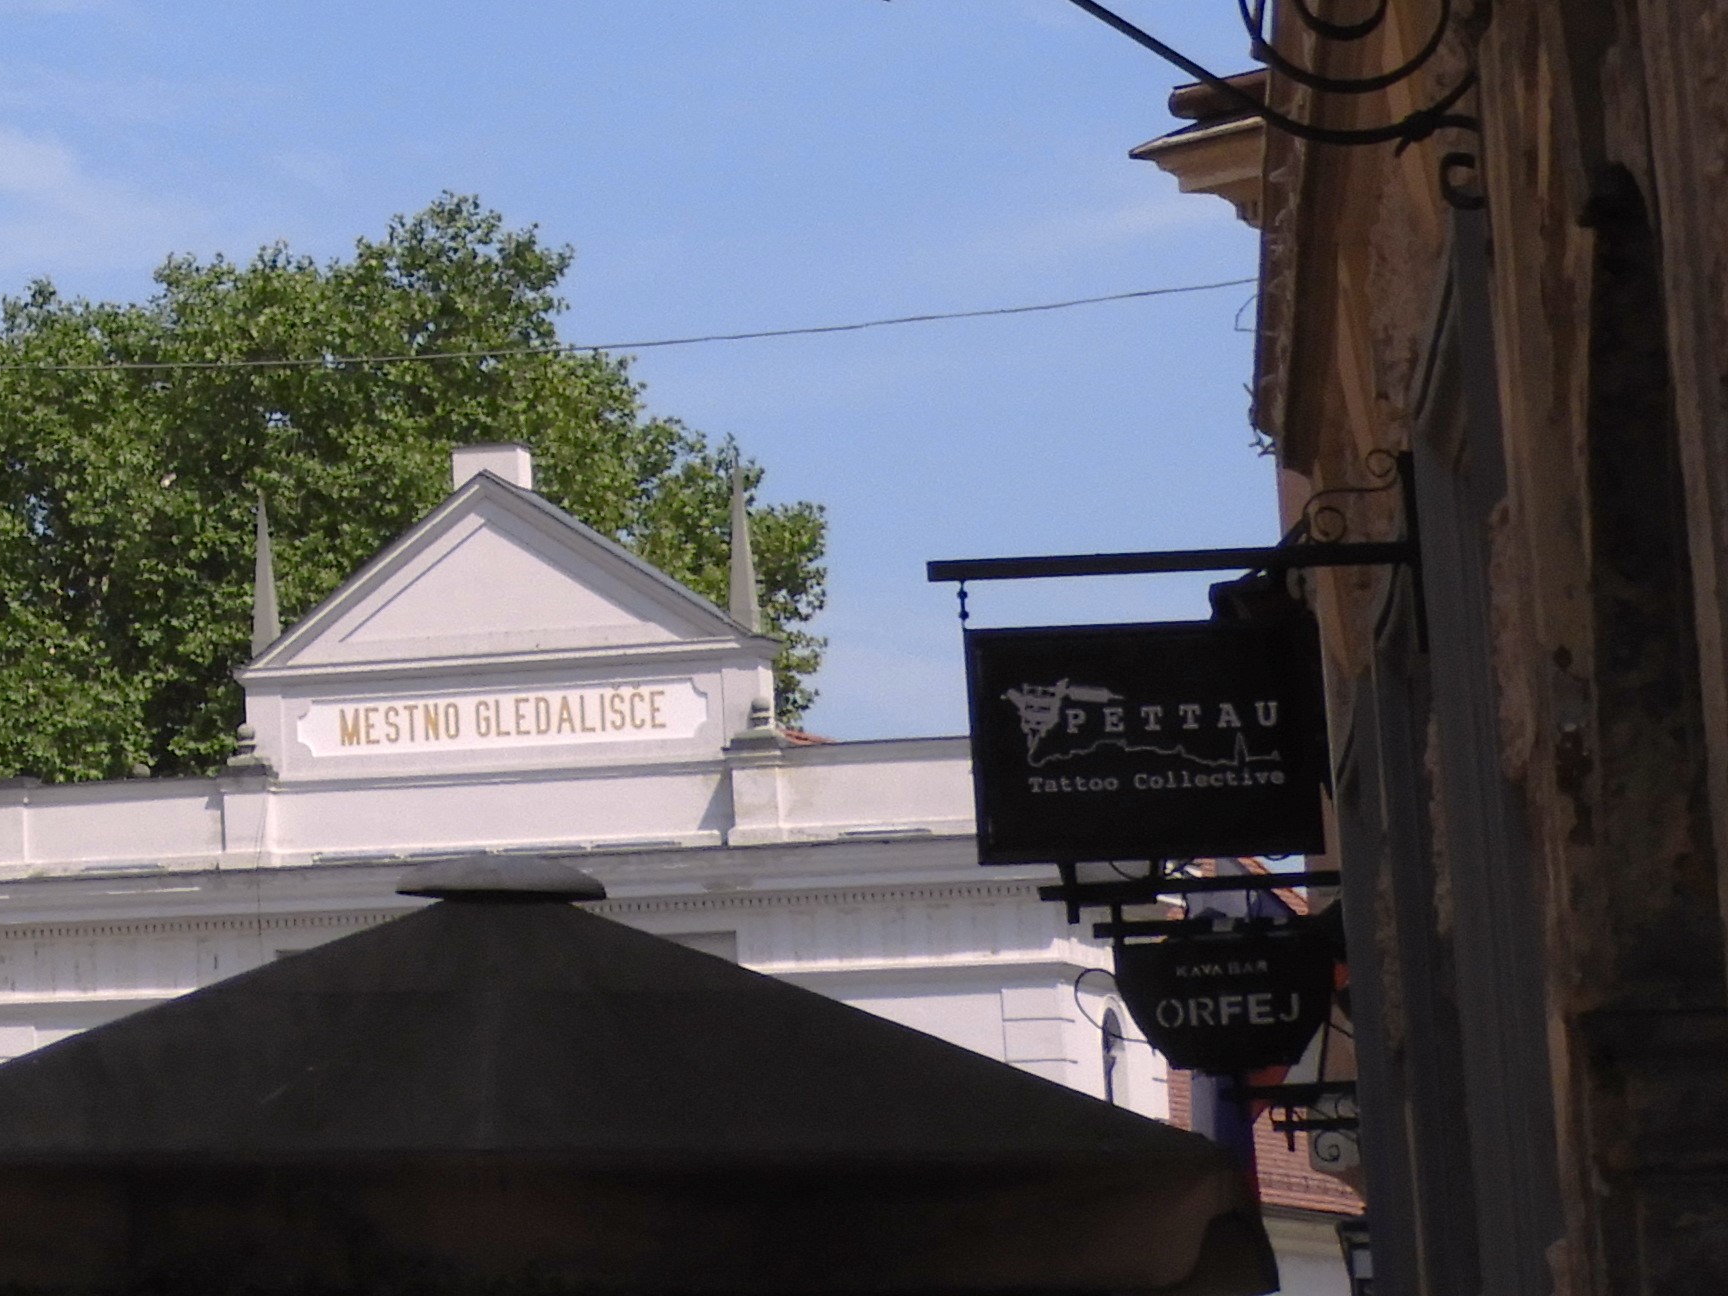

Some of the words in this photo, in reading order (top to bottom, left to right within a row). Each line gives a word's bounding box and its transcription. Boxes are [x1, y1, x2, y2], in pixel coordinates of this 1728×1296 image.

[339, 700, 461, 747] MESTNO
[475, 681, 667, 737] GLEDALIŠČE
[1065, 702, 1279, 734] PETTAU
[1028, 773, 1120, 794] Tattoo
[1134, 768, 1285, 790] Collective
[1175, 963, 1224, 978] KAVA
[1228, 959, 1269, 975] BAR
[1155, 992, 1301, 1029] ORFEJ
